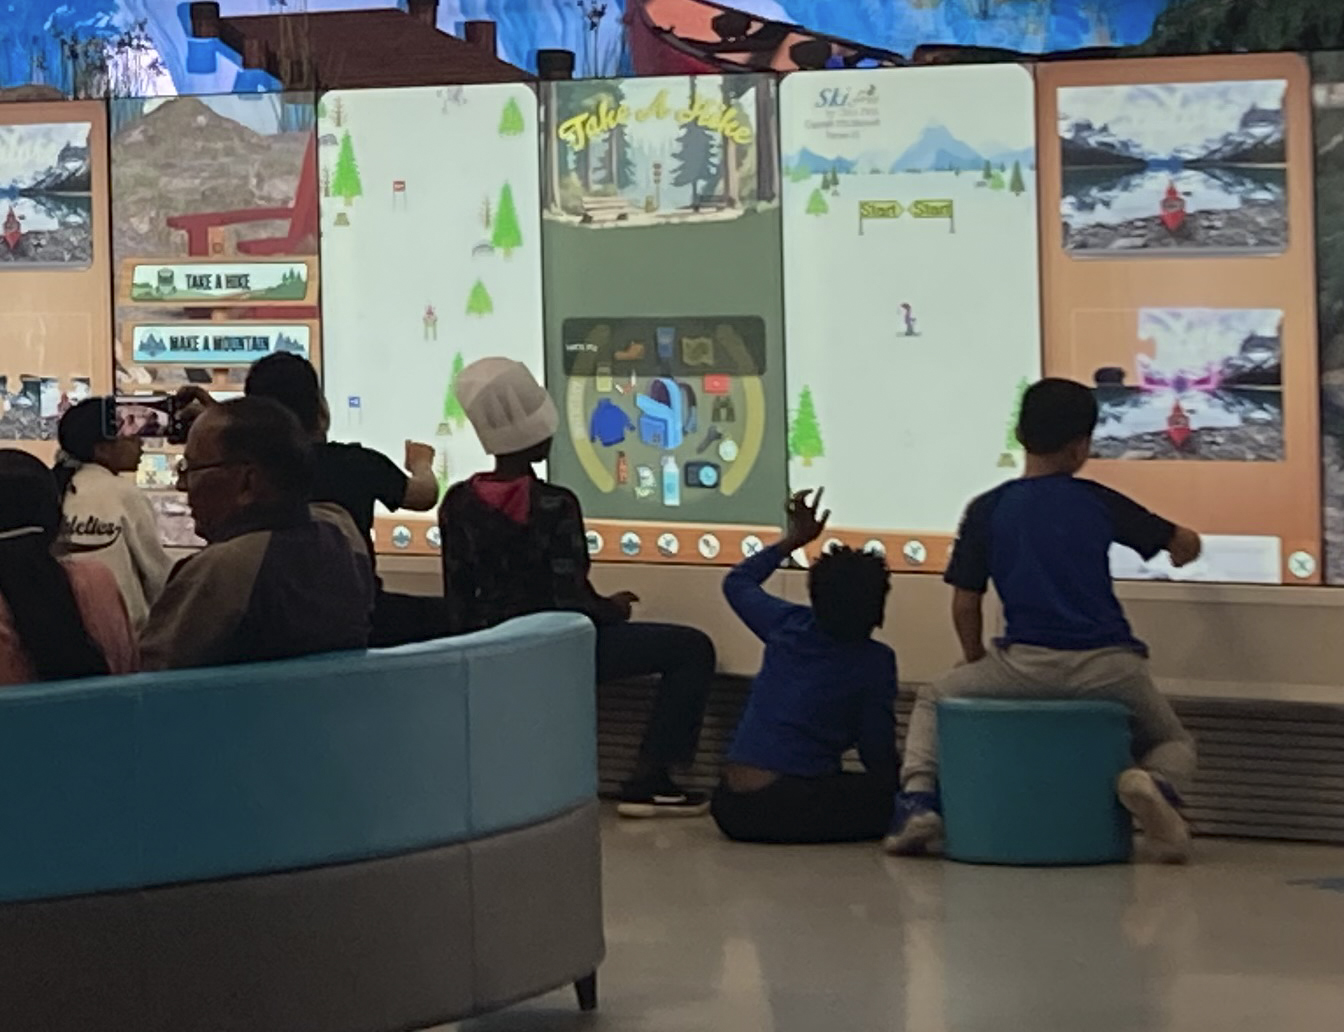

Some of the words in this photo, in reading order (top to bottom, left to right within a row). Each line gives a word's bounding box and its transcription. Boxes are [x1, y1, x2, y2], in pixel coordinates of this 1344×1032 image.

[558, 100, 629, 152] Take
[635, 88, 670, 121] A
[675, 92, 754, 145] Hike
[185, 274, 212, 290] TAKE
[215, 274, 222, 290] A
[225, 273, 251, 290] HIKE
[169, 335, 199, 352] MAKE
[202, 335, 210, 352] A
[213, 335, 270, 352] MOUNTAIN
